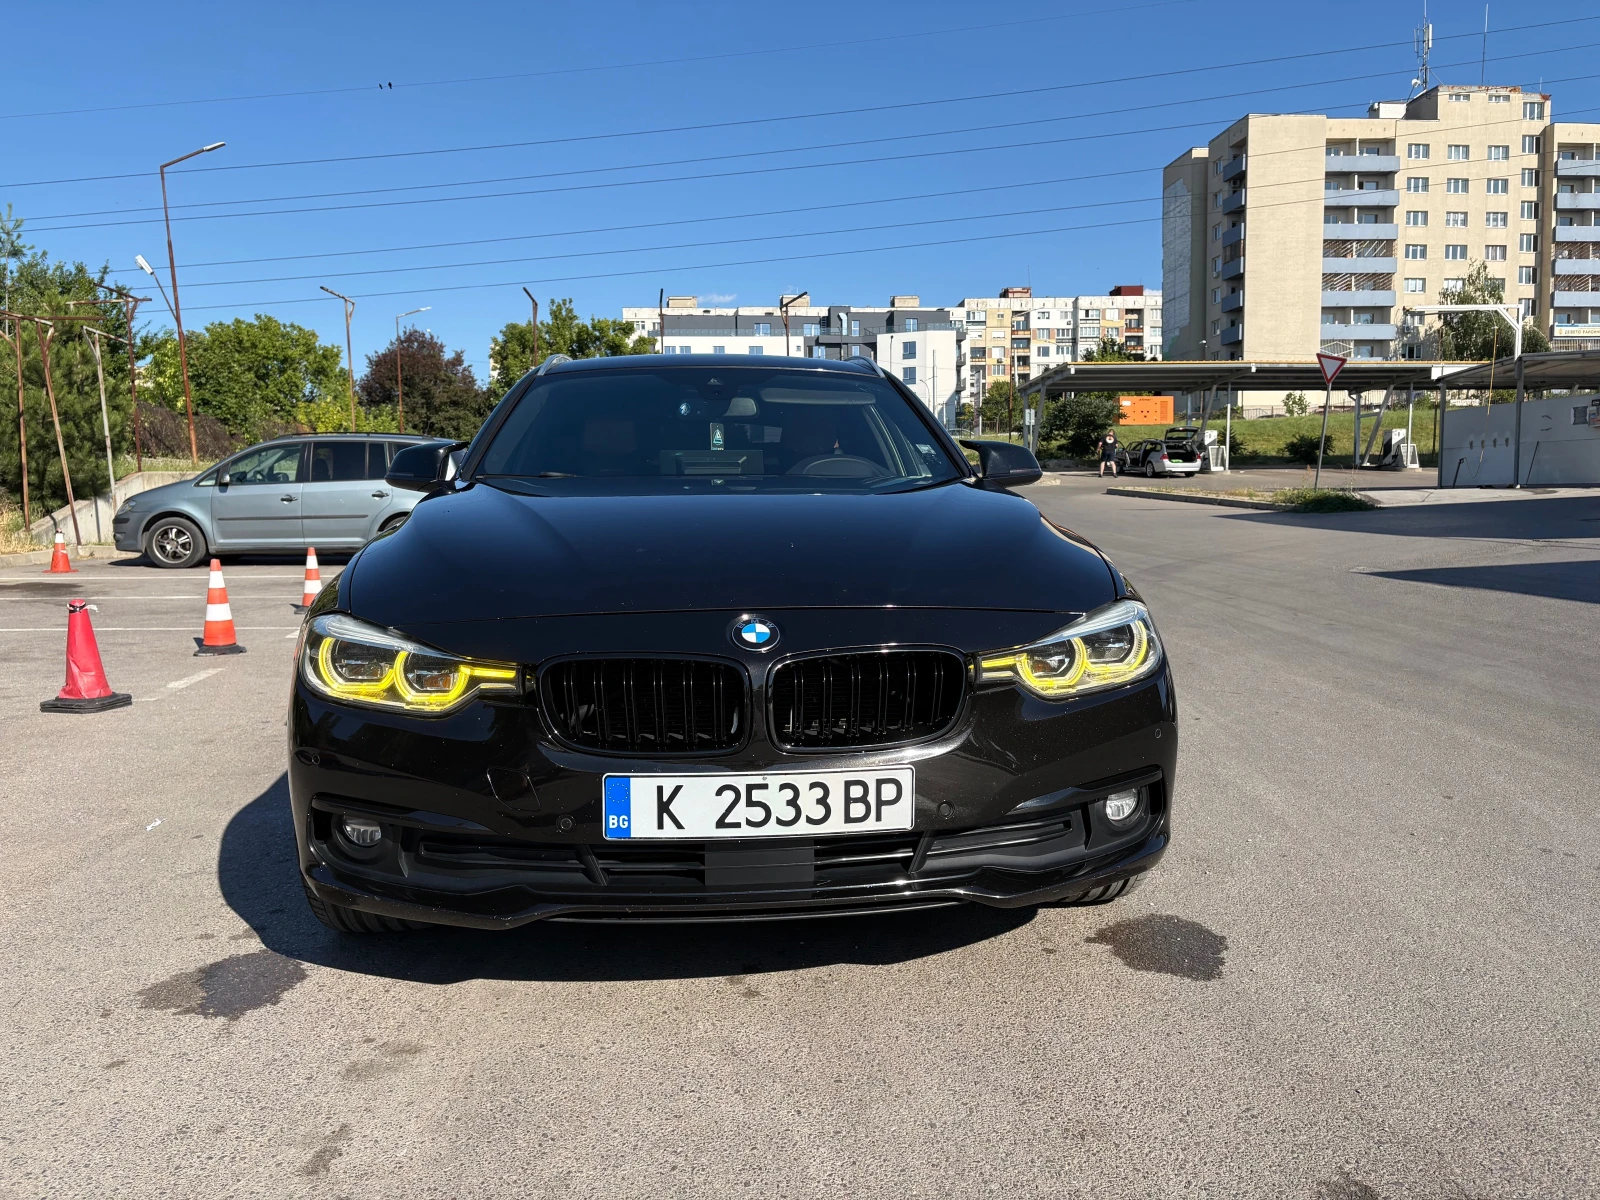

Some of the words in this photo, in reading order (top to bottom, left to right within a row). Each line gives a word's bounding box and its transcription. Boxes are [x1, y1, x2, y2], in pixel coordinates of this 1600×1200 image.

[737, 618, 775, 629] BMW
[655, 784, 686, 831] K
[714, 782, 833, 830] 2533
[843, 777, 903, 825] BP
[608, 814, 630, 829] BG
